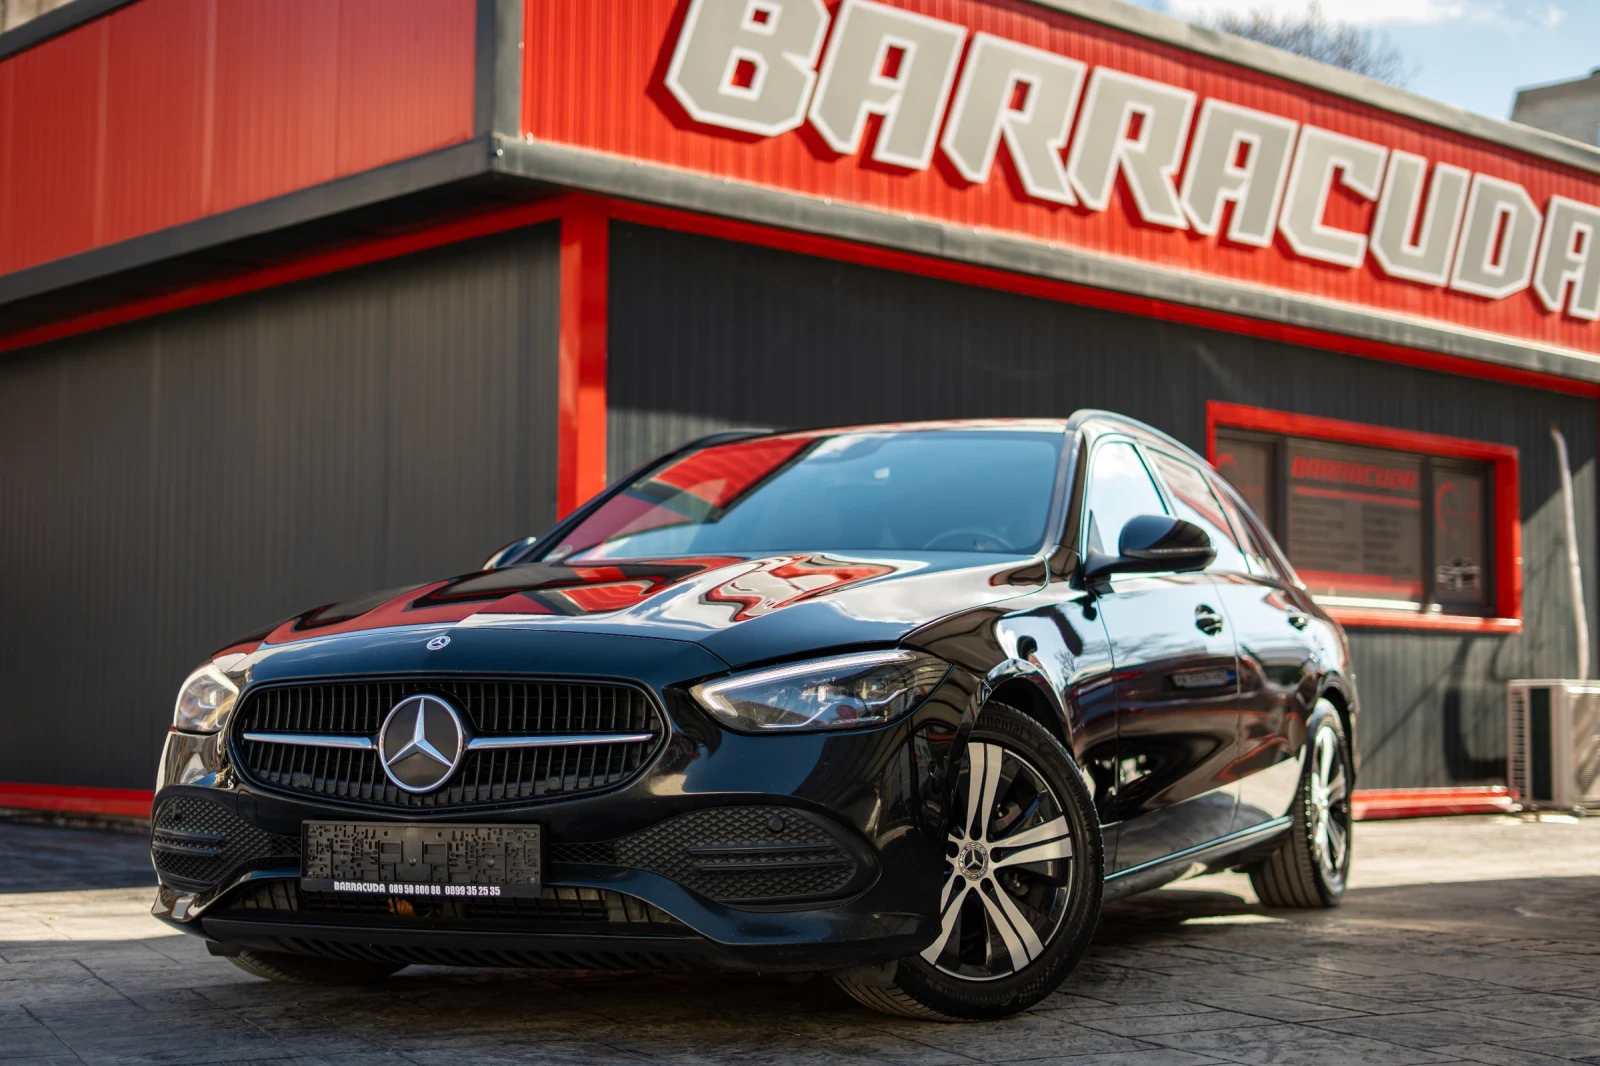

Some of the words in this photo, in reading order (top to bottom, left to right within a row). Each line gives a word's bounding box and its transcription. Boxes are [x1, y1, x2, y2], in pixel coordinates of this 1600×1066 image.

[664, 0, 1600, 320] BARRACUDA
[333, 881, 386, 893] BARRACUDA
[389, 883, 404, 894] 089
[404, 884, 414, 895] 50
[415, 884, 430, 895] 800
[430, 885, 441, 895] 88
[445, 885, 466, 896] 0899
[466, 886, 477, 896] 35
[478, 886, 489, 897] 25
[490, 886, 501, 897] 35
